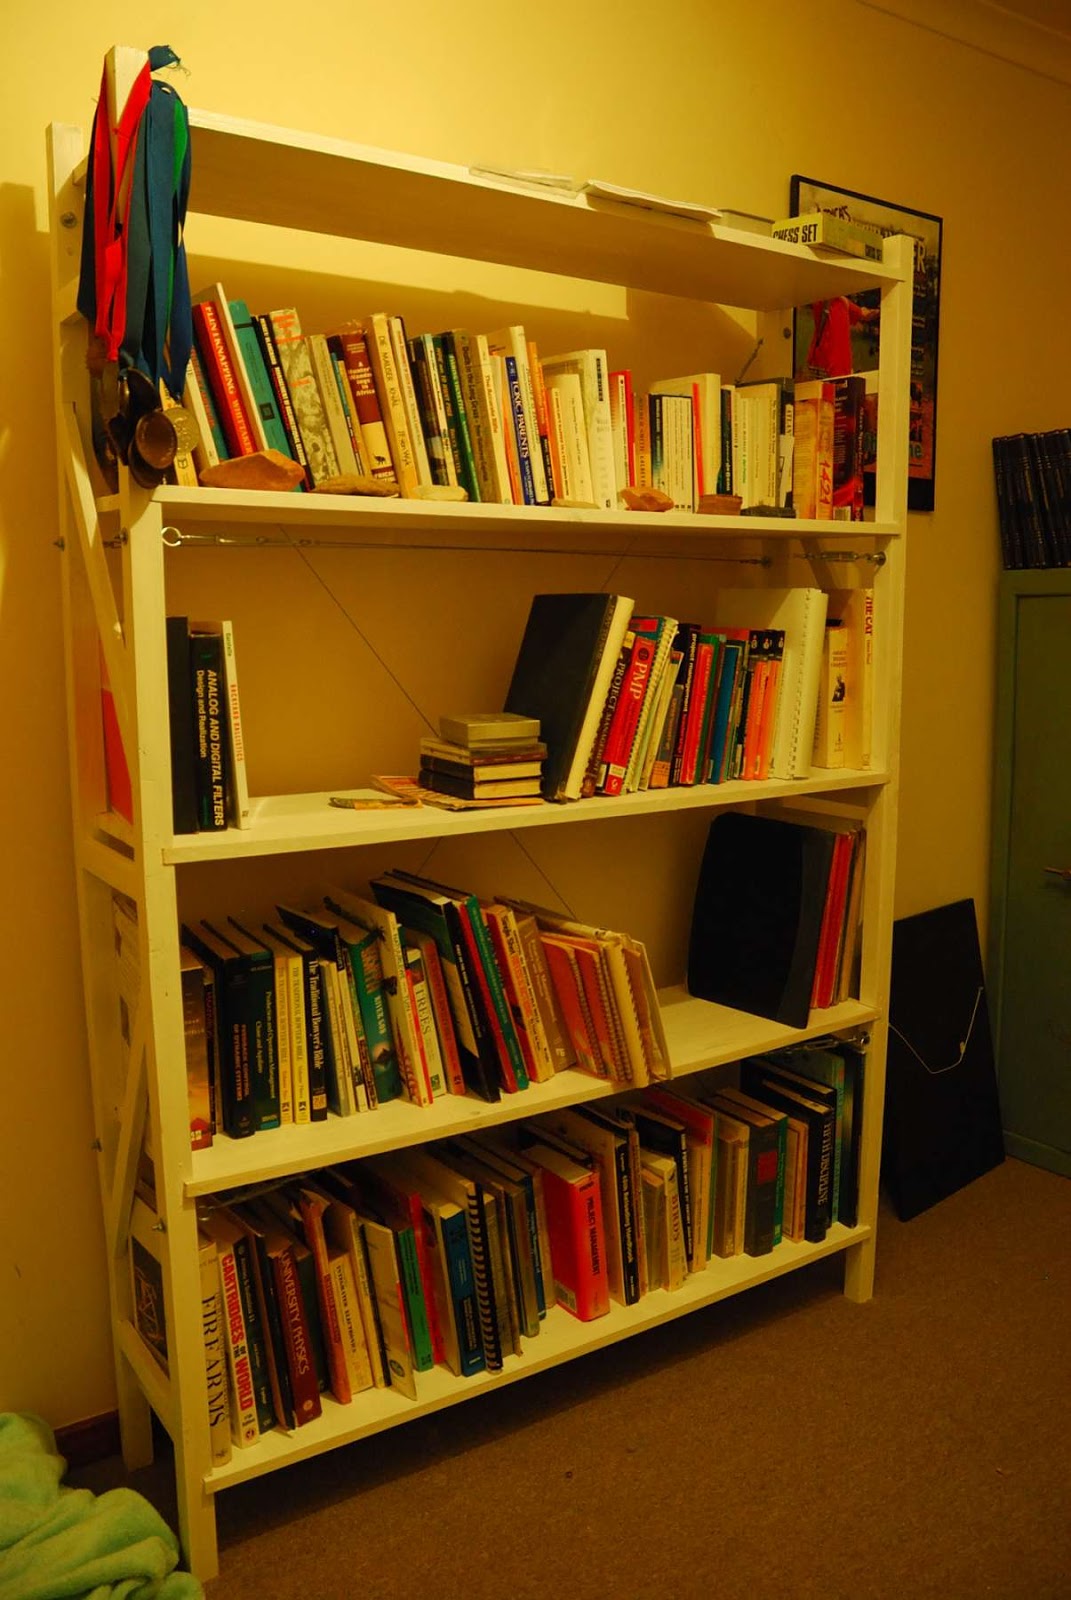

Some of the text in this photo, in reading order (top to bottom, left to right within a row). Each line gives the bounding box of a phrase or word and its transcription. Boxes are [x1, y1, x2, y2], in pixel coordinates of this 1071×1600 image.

[773, 224, 818, 244] CHESS SET
[203, 305, 236, 395] FLINTKNAPPING
[377, 334, 387, 347] DIE
[460, 345, 471, 366] Death
[380, 350, 394, 382] MAUSER
[465, 372, 474, 384] the
[355, 389, 376, 397] Africa
[466, 383, 477, 401] Long
[483, 374, 499, 433] The Accurate Rifle
[510, 379, 529, 458] TOXIC PARENTS
[399, 447, 412, 467] Wyk
[818, 459, 831, 504] 1421
[864, 595, 873, 636] THE CAT
[687, 632, 699, 662] project
[604, 660, 627, 712] PROJECT
[626, 660, 649, 701] PMP
[680, 661, 695, 712] management
[194, 669, 207, 758] Design and Realization
[229, 683, 239, 720] BACKYARD
[206, 668, 224, 826] ANALOG AND DIGITAL FILTERS
[233, 722, 243, 762] BALLISTICS
[590, 712, 614, 773] MANAGEMENT
[500, 915, 516, 955] Single Shot
[308, 959, 319, 975] The
[264, 990, 272, 1022] Production
[291, 978, 301, 1016] TRADITIONAL
[309, 975, 321, 1016] Traditional
[372, 994, 387, 1035] RIVER GOD
[413, 987, 432, 1036] TREES
[255, 1038, 263, 1049] and
[265, 1021, 273, 1033] and
[232, 1023, 243, 1101] OF DYNAMIC SYSTEMS
[240, 1023, 250, 1096] FEEDBACK CONTROL
[312, 1049, 324, 1069] Bible
[266, 1062, 275, 1099] Management
[816, 1122, 833, 1207] FIFTH DISCIPLINE
[621, 1191, 631, 1227] Reloading
[670, 1194, 680, 1241] BIRDS
[585, 1195, 600, 1276] PROJECT MANAGEMENT
[625, 1226, 634, 1263] Handbook
[279, 1251, 310, 1375] UNIVERSITY PHYSICS
[334, 1264, 357, 1353] INTEGRATED ELECTRONICS
[220, 1253, 253, 1411] CARTRIDGES OF THE WORLD
[200, 1295, 225, 1428] FIREARMS
